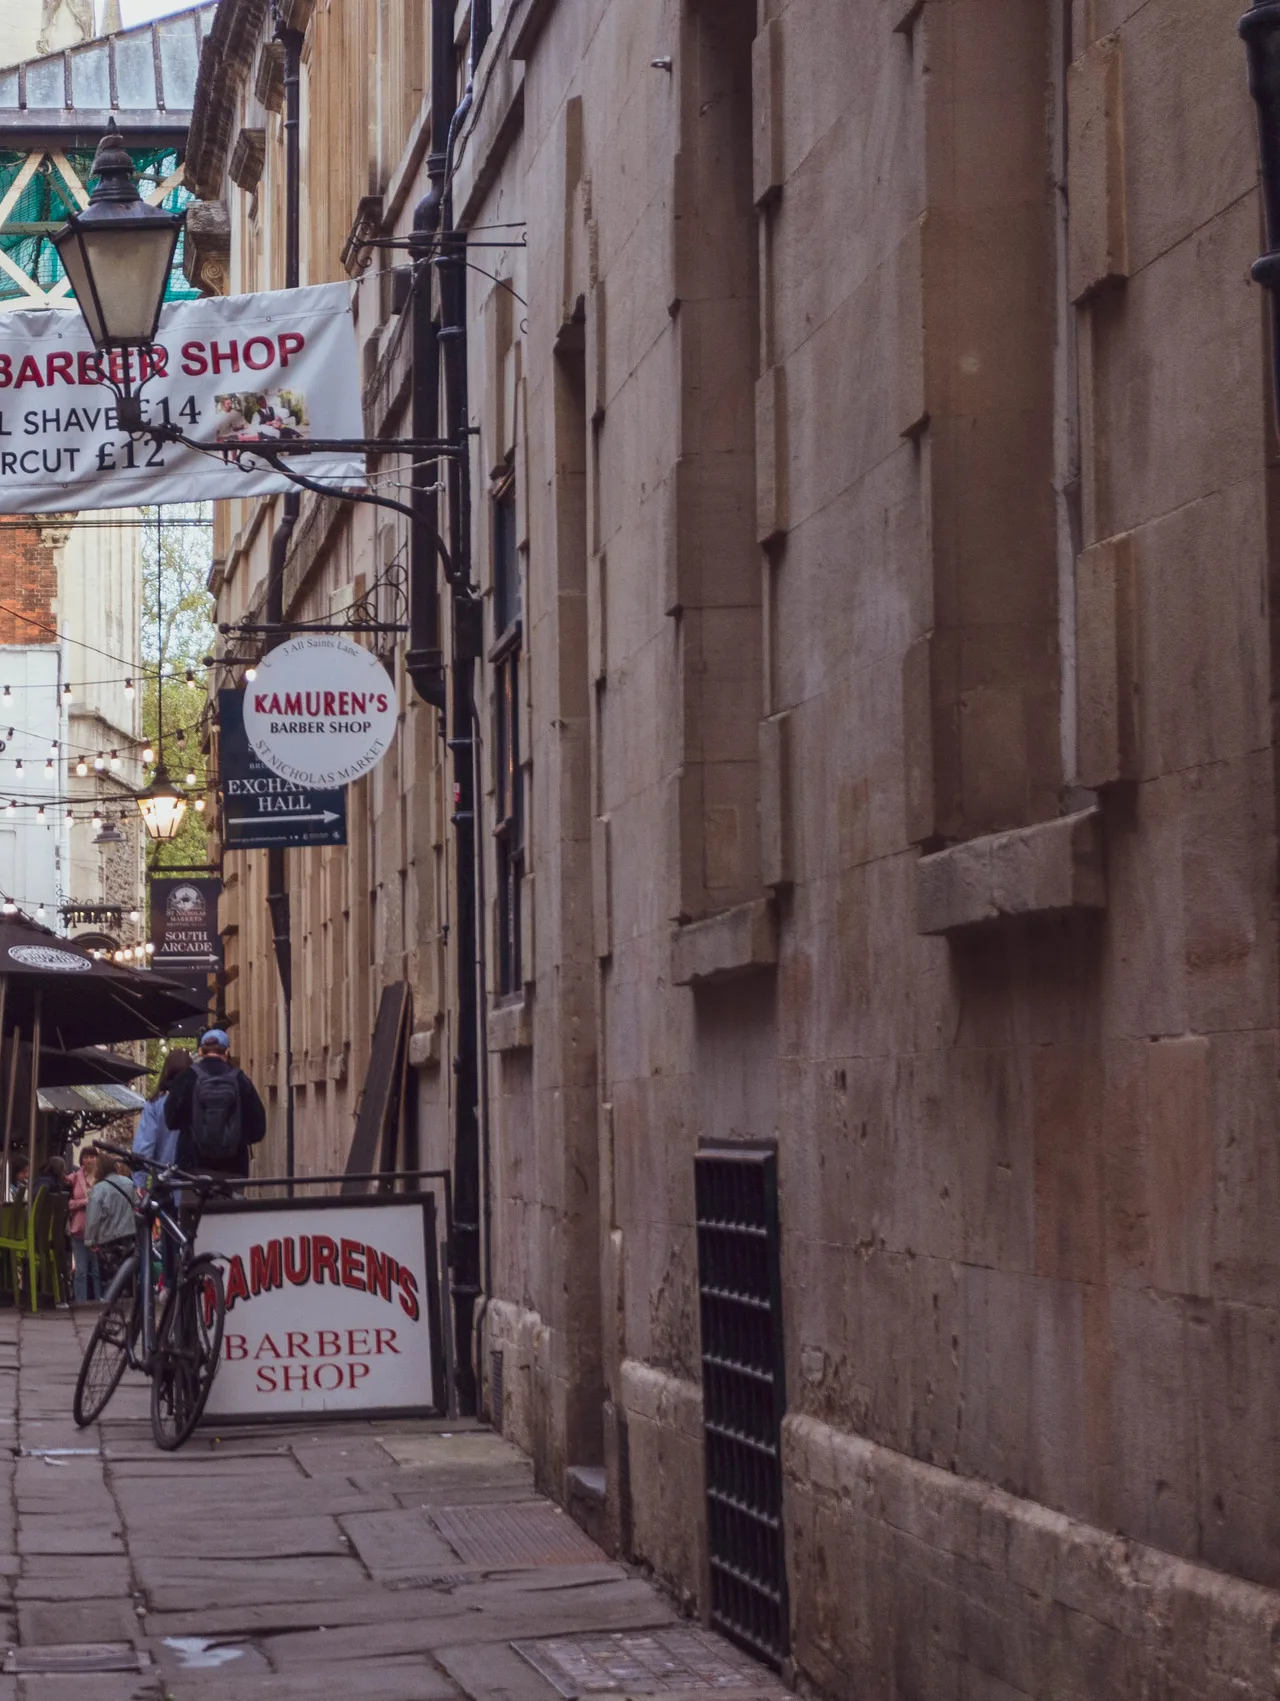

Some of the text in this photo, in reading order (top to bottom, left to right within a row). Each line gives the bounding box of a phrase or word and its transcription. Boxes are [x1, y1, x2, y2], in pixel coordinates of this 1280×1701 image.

[181, 332, 305, 376] SHOP
[23, 407, 120, 435] SHAVE
[96, 439, 164, 471] £12
[291, 640, 305, 652] All
[307, 638, 335, 648] Saints
[337, 641, 360, 657] Lane
[254, 691, 388, 717] KAMUREN'S
[270, 721, 372, 734] BARBER SHOP
[256, 738, 385, 783] ST NICHOLAS MARKET
[228, 777, 340, 795] EXCHA
[258, 795, 312, 812] HALL
[161, 942, 213, 952] ARCADE
[165, 931, 208, 941] SOUTH
[223, 1328, 402, 1361] BARBER
[256, 1362, 370, 1393] SHOP
